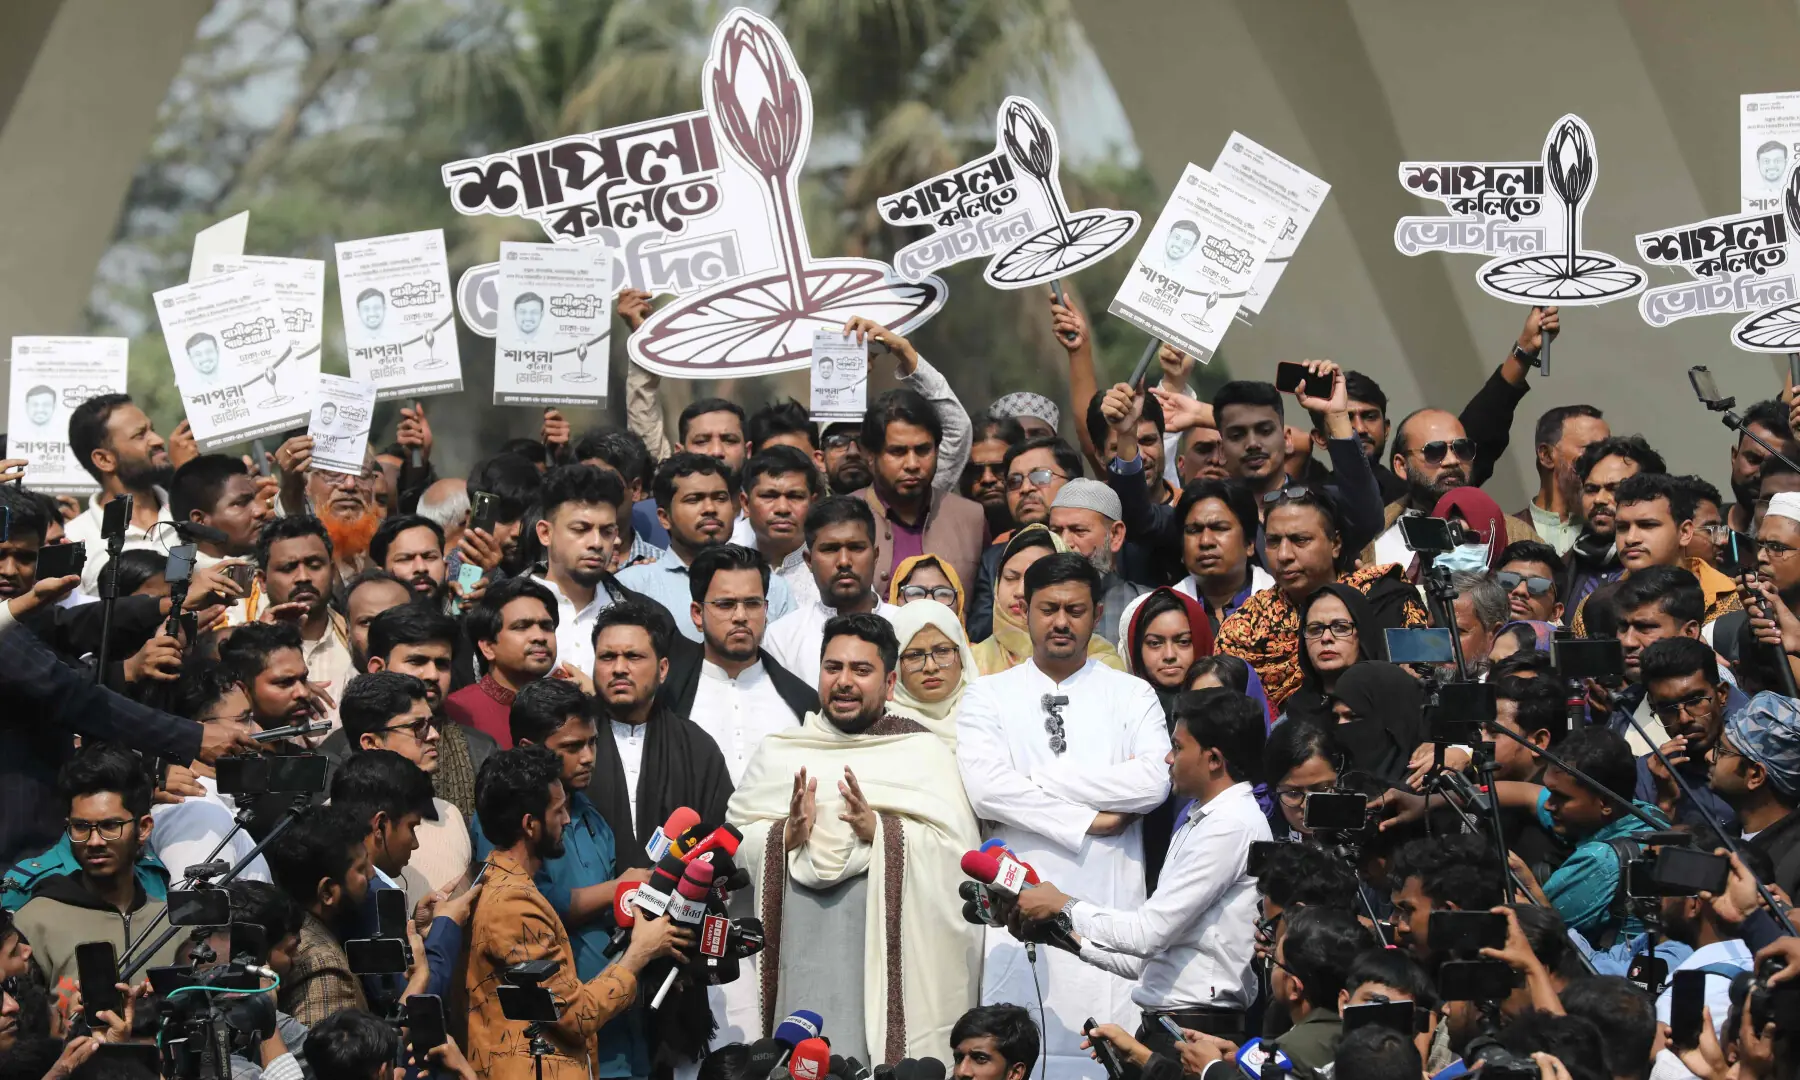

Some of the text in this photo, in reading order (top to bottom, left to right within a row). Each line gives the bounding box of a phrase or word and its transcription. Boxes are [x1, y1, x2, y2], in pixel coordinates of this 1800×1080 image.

[451, 116, 718, 209] শাপলা
[883, 154, 1015, 220] শাপলা
[1405, 166, 1544, 195] শাপলা
[547, 176, 718, 237] কলিতে
[934, 184, 1017, 226] কলিতে
[1450, 189, 1540, 222] কলিতে
[1643, 213, 1787, 260] শাপলা
[1693, 246, 1786, 276] কলিতে
[1140, 265, 1185, 298] শাপলা
[355, 344, 402, 360] শাপলা
[504, 350, 552, 363] শাপলা
[192, 385, 244, 406] শাপলা
[16, 442, 66, 453] শাপলা
[1004, 864, 1018, 887] DBC
[217, 1030, 228, 1080] Panasonic
